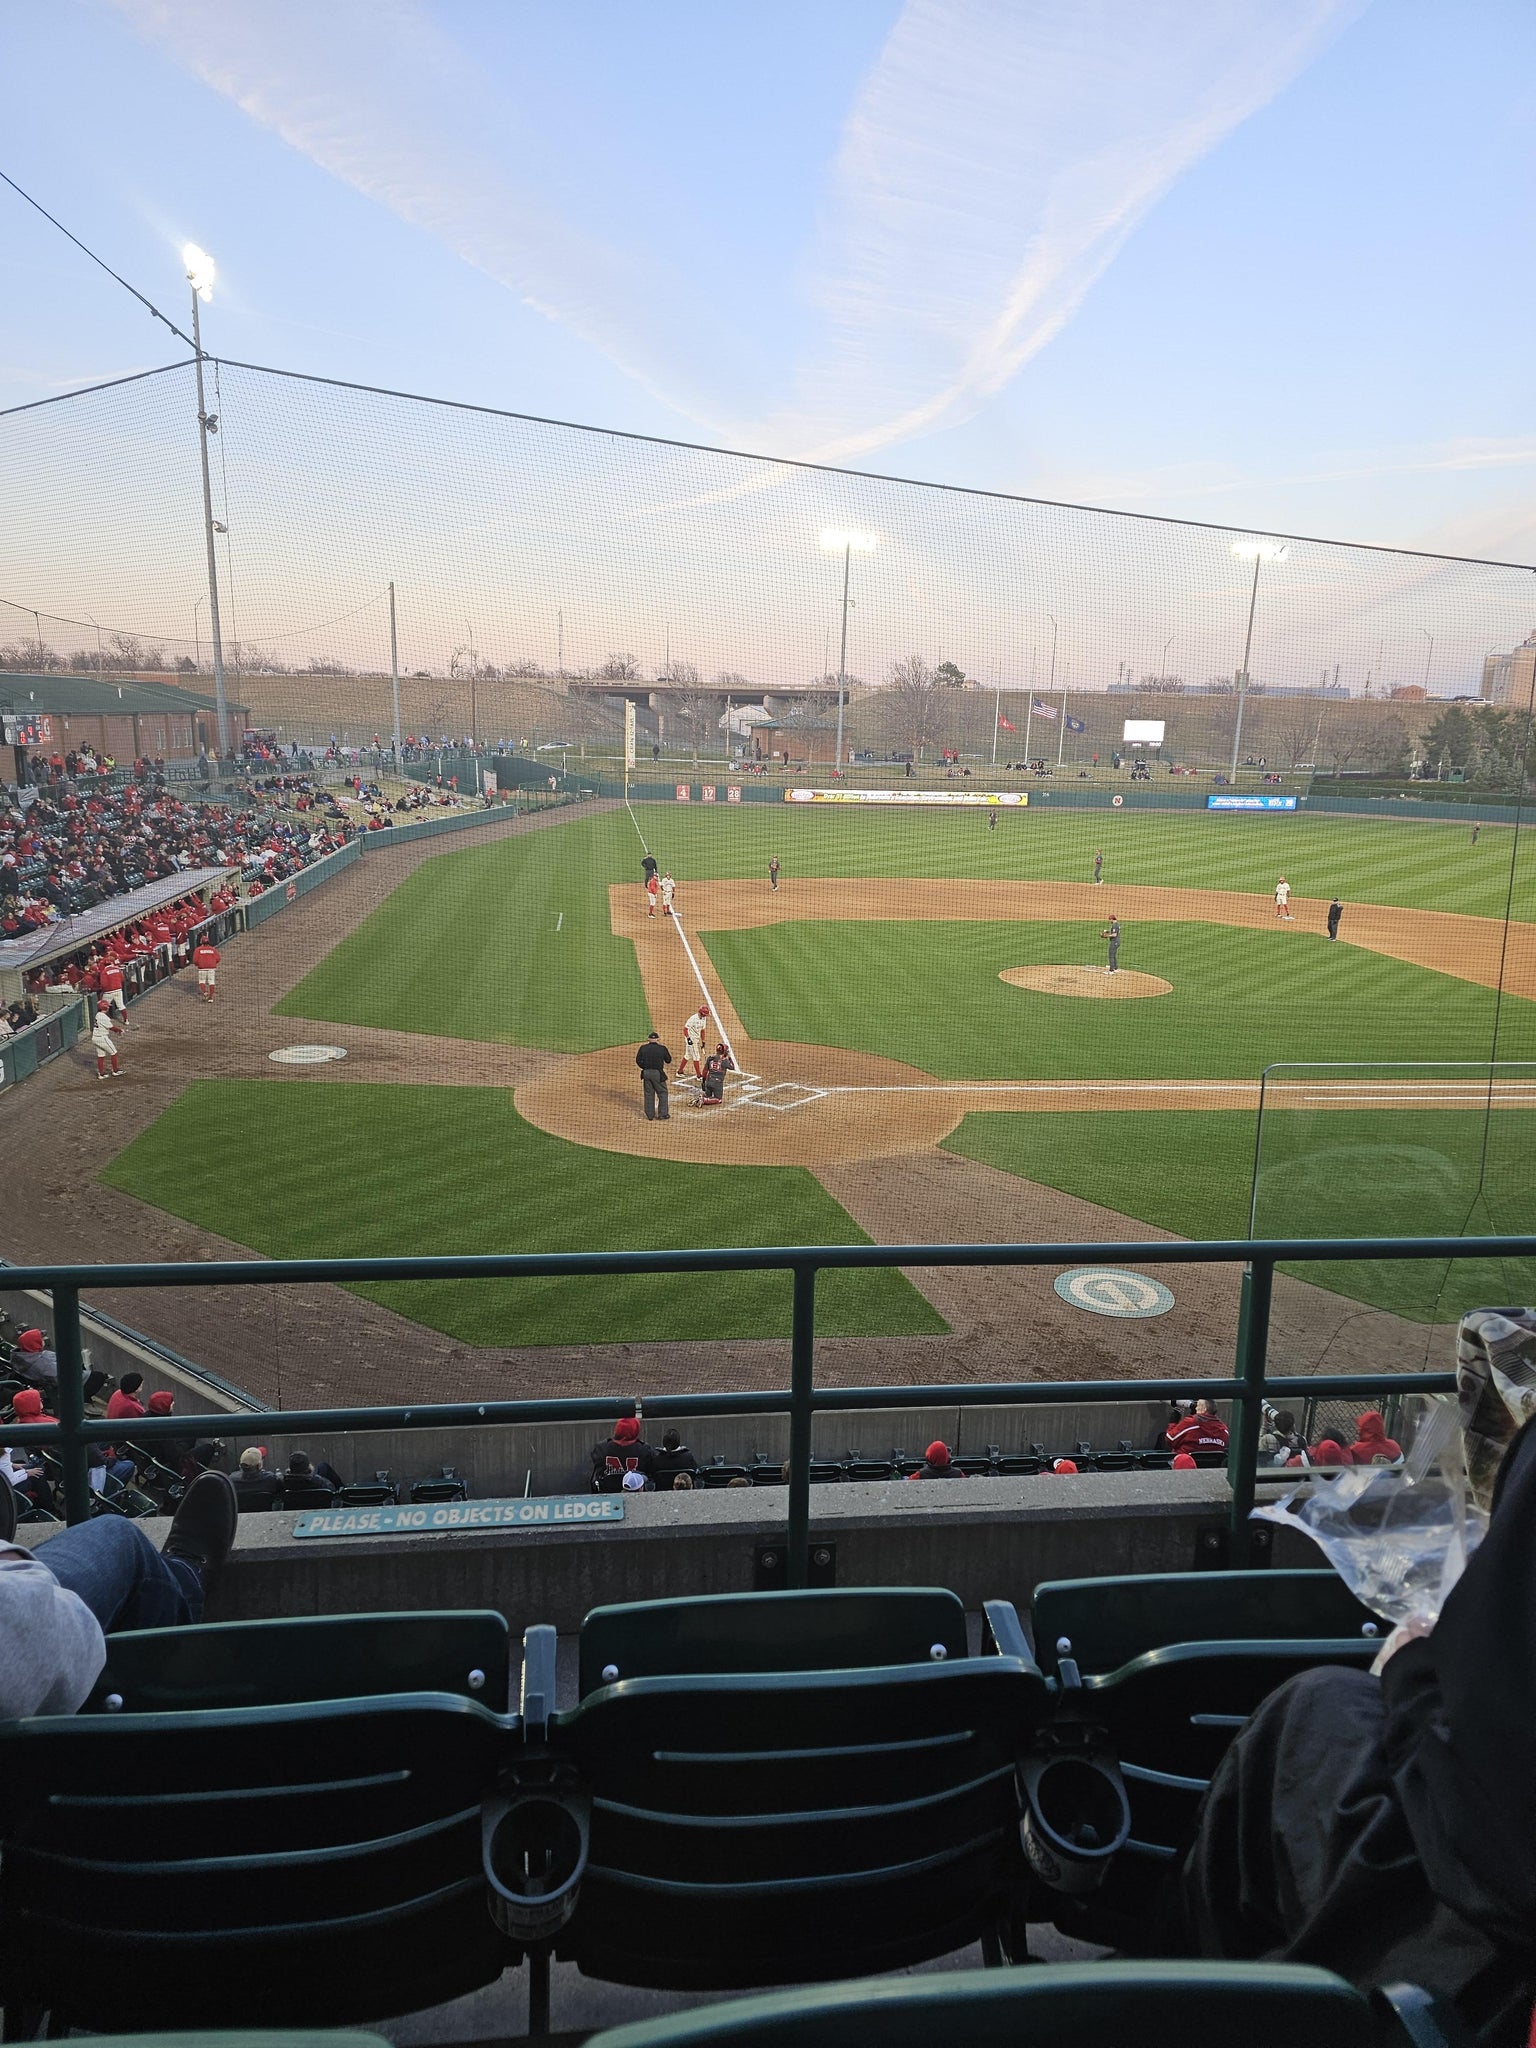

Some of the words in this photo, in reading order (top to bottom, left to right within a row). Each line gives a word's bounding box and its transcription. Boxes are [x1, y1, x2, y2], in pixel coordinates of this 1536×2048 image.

[704, 789, 714, 797] 17
[728, 790, 739, 798] 28
[309, 1512, 381, 1532] PLEASE
[396, 1510, 427, 1528] NO
[432, 1505, 515, 1525] OBJECTS
[519, 1504, 549, 1521] ON
[554, 1500, 612, 1520] LEDGE
